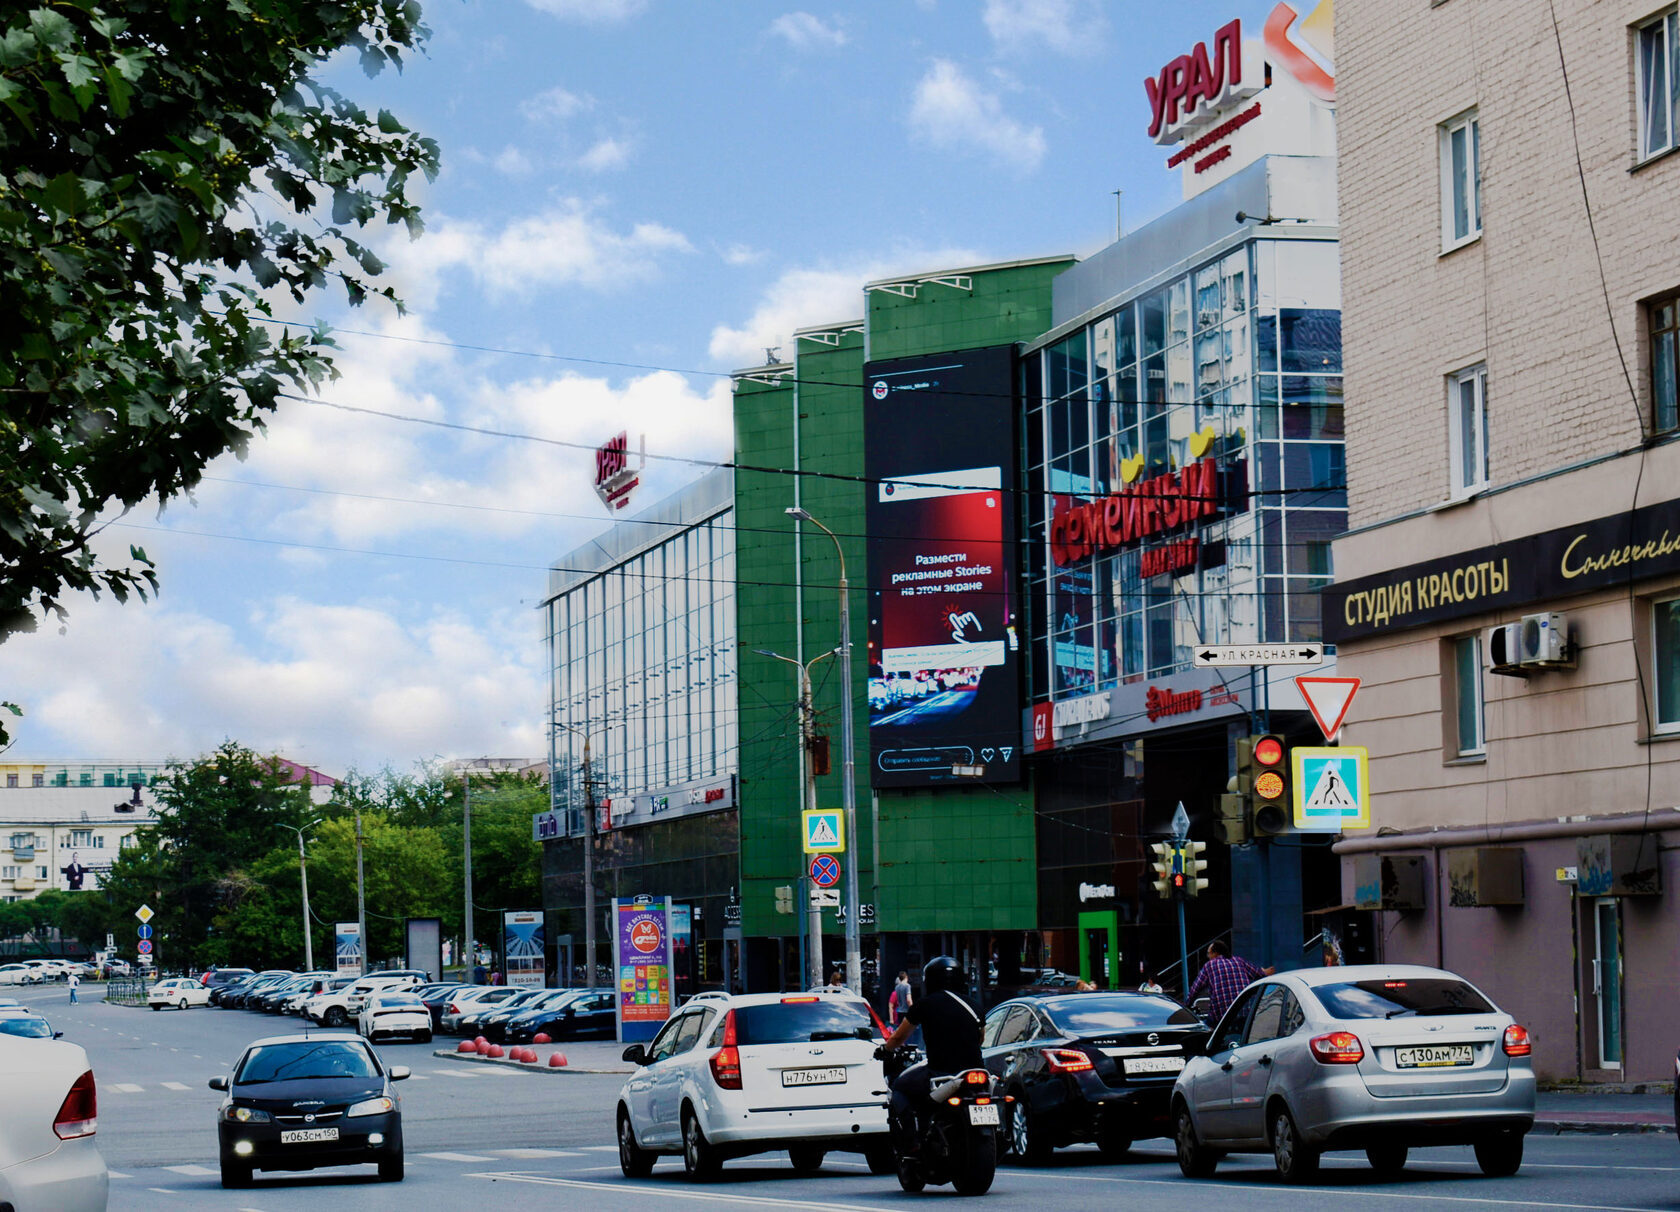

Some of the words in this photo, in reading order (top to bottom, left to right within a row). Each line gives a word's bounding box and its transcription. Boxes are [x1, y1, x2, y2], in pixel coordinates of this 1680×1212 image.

[1144, 18, 1241, 138] УРАЛ
[595, 430, 627, 486] УРАЛ
[915, 552, 967, 566] Размести
[891, 568, 953, 584] рекламные
[955, 564, 992, 577] Stories
[901, 586, 914, 596] на
[916, 584, 941, 595] этом
[943, 580, 983, 593] экране
[1344, 580, 1413, 627] СТУДИЯ
[1417, 558, 1509, 611] КРАСОТЫ
[1241, 650, 1296, 660] КРАСНАЯ
[1452, 1047, 1470, 1058] 774
[829, 1070, 844, 1079] 174
[323, 1129, 337, 1137] 150
